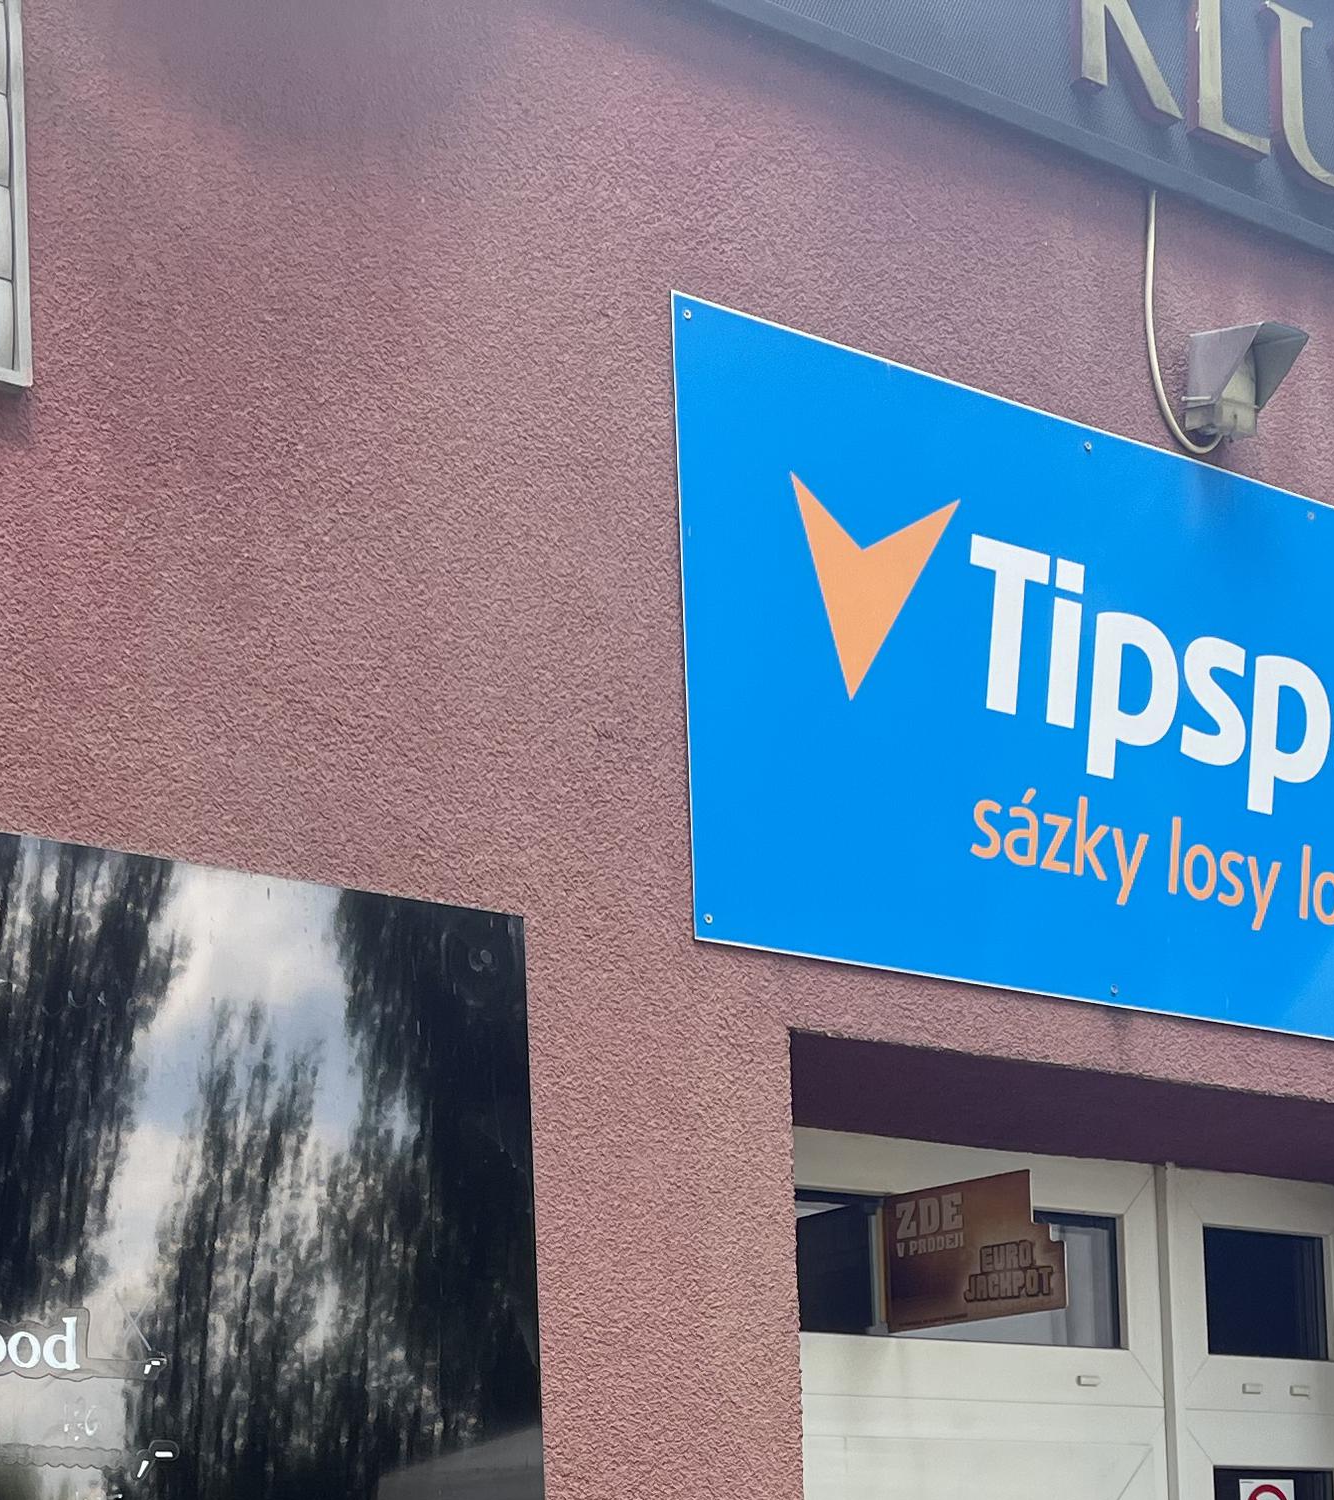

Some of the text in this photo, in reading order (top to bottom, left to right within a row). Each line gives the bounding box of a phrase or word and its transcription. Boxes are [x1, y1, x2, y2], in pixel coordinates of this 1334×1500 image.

[971, 787, 1149, 905] sázky
[1166, 815, 1281, 931] losy
[896, 1192, 964, 1241] ZDE
[897, 1231, 965, 1258] V PRODEJI
[979, 1241, 1035, 1272] EURO
[965, 1266, 1053, 1301] JACKPOT
